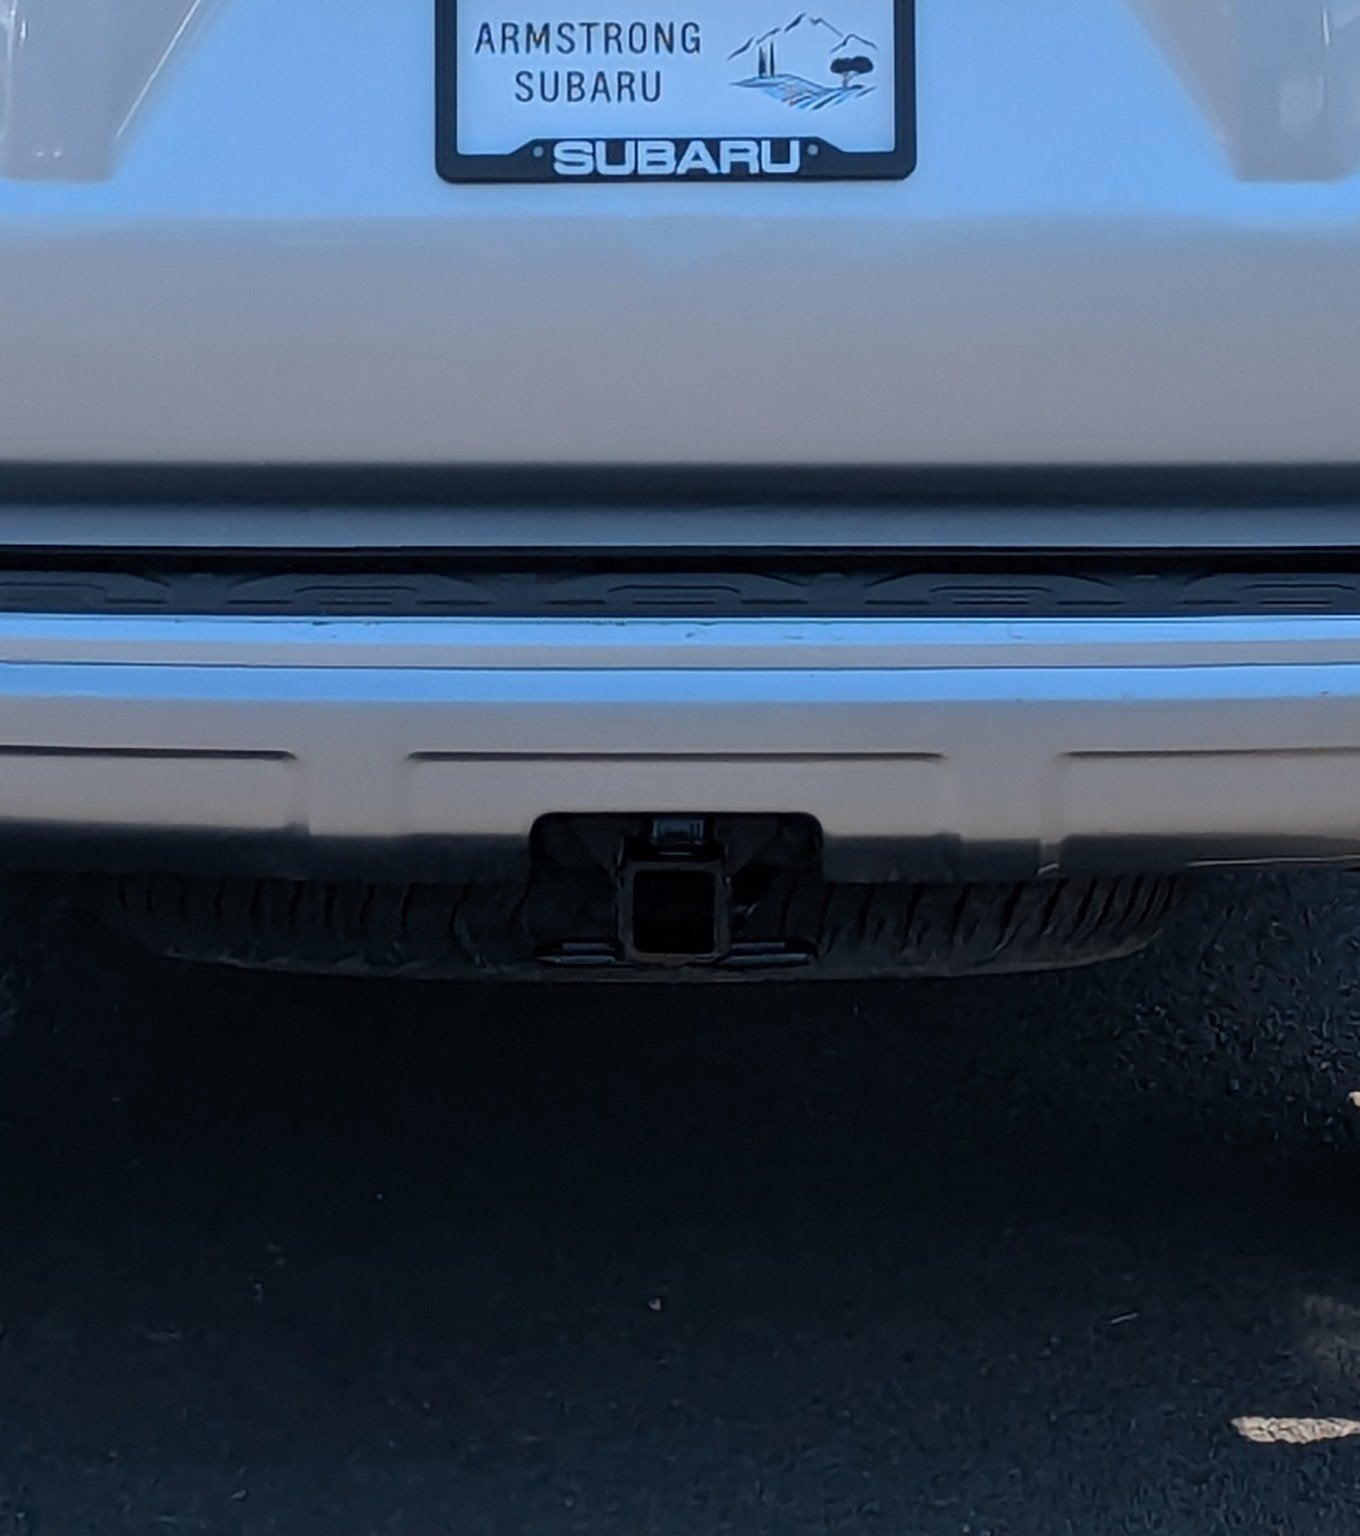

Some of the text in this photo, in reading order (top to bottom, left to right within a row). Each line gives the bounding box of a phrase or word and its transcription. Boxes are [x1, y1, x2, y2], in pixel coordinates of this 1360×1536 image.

[474, 21, 702, 55] ARMSTRONG
[514, 70, 662, 103] SUBARU
[552, 139, 801, 175] SUBARU
